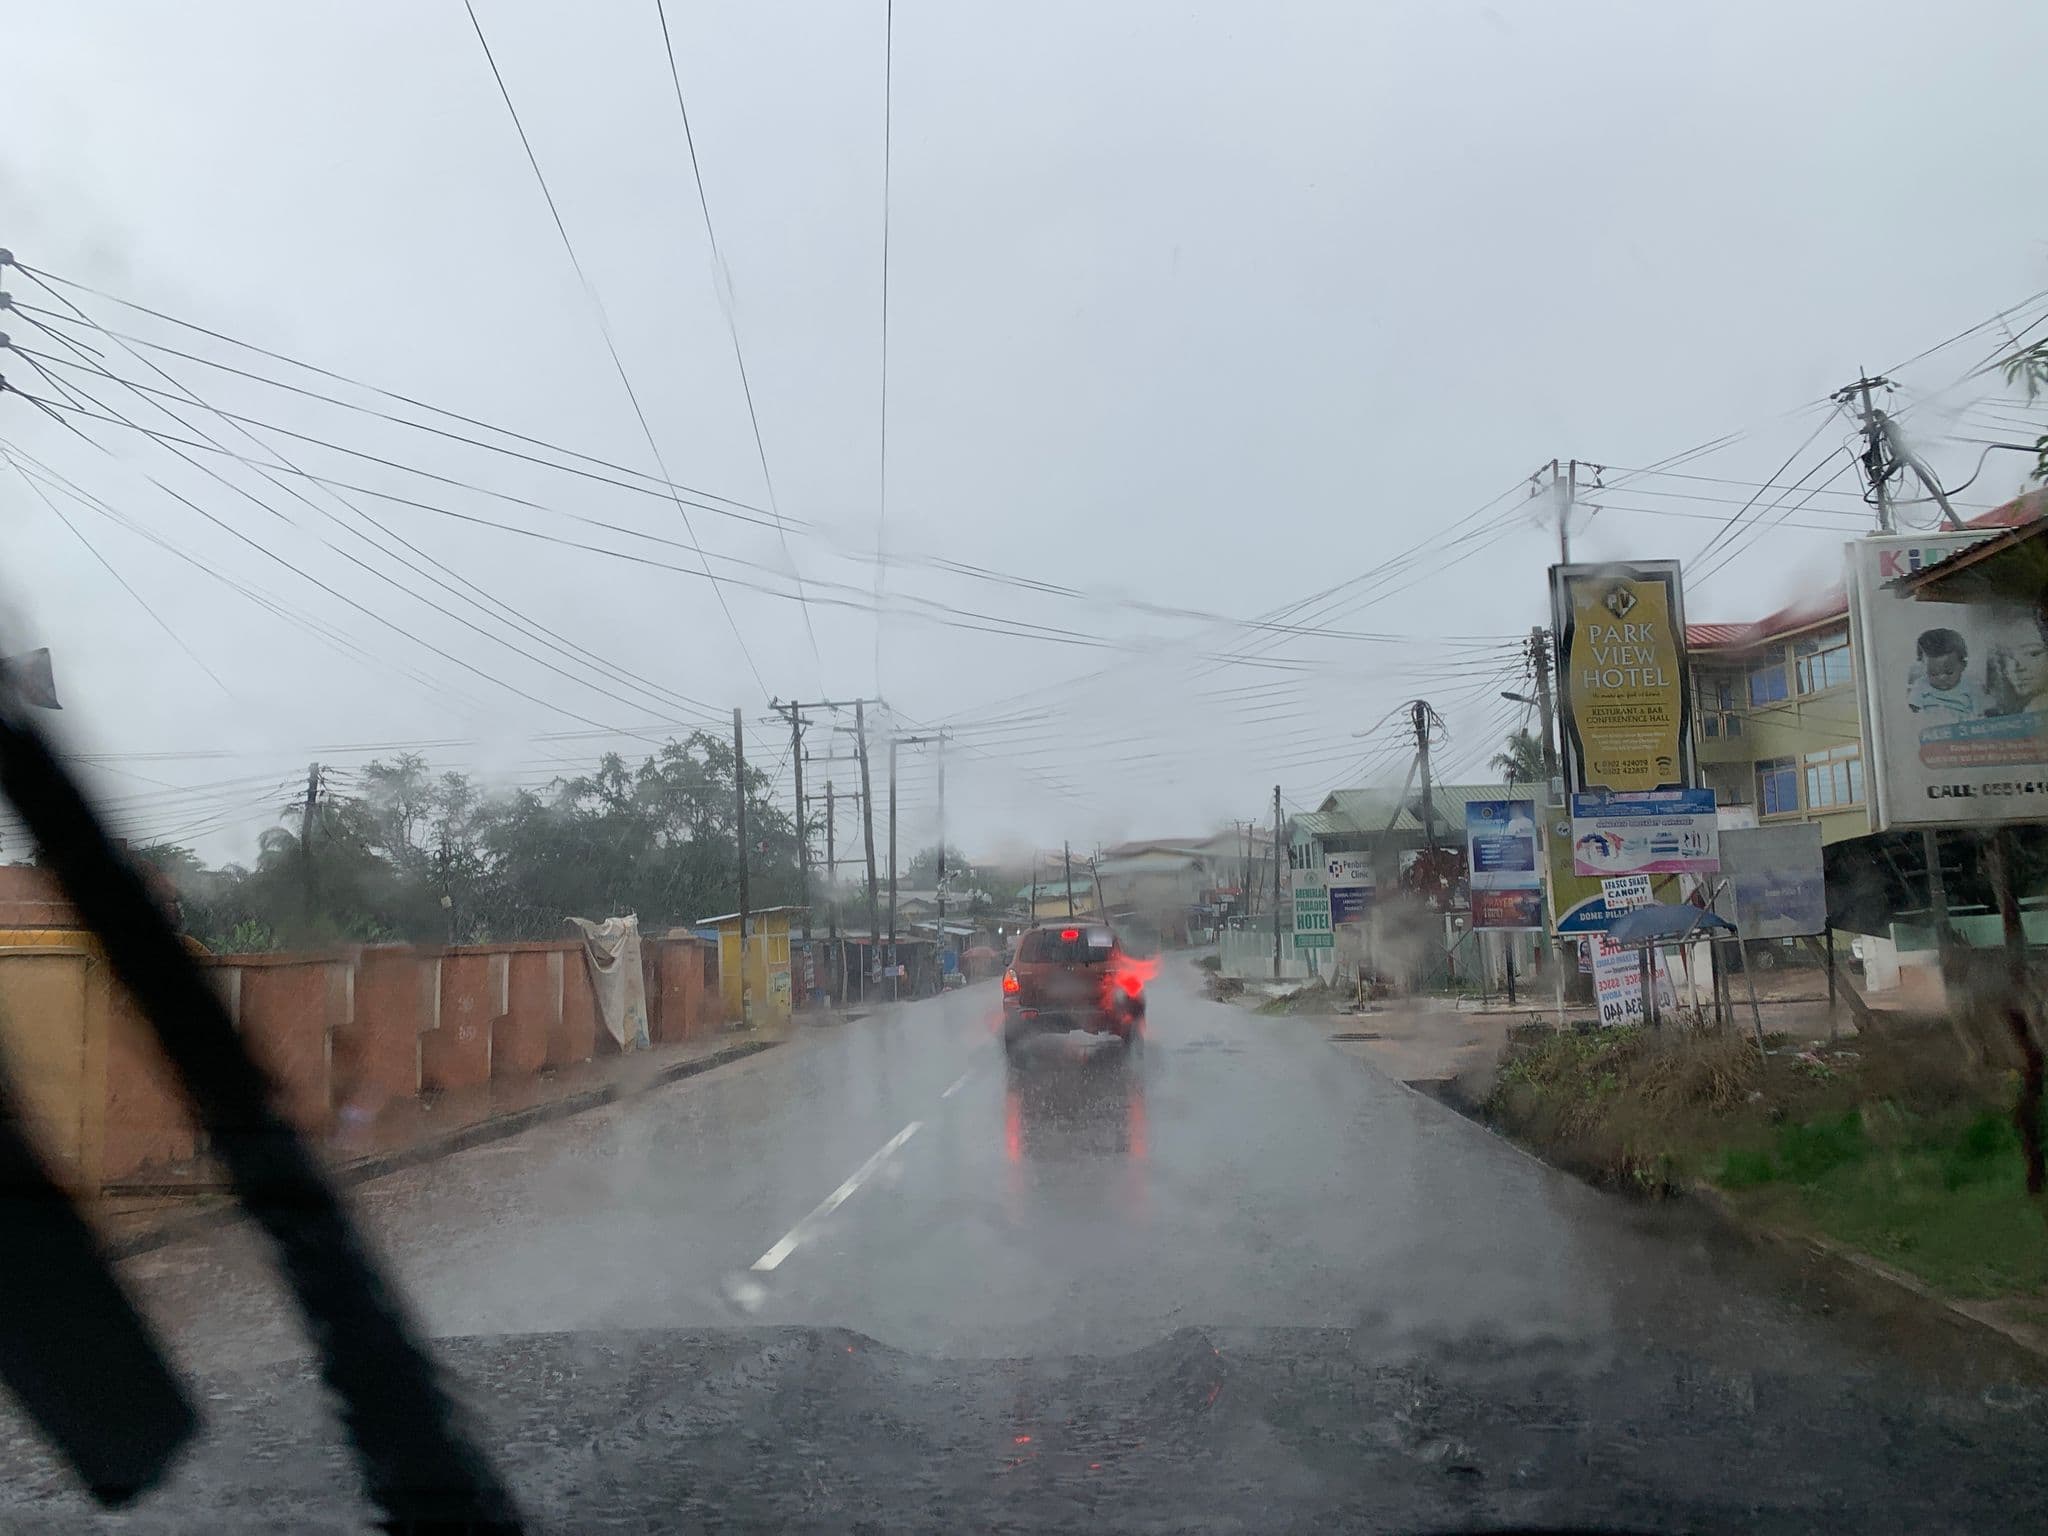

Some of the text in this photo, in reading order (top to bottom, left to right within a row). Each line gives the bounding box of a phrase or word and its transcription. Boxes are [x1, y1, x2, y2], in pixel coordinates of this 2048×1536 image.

[1590, 623, 1655, 644] PARK
[1591, 645, 1656, 666] VIEW
[1583, 667, 1671, 689] HOTEL
[1647, 706, 1663, 714] BAR
[1649, 714, 1670, 722] HALL
[1351, 870, 1369, 879] Clinic
[1608, 887, 1646, 898] CANOPY
[1579, 911, 1603, 921] DOME
